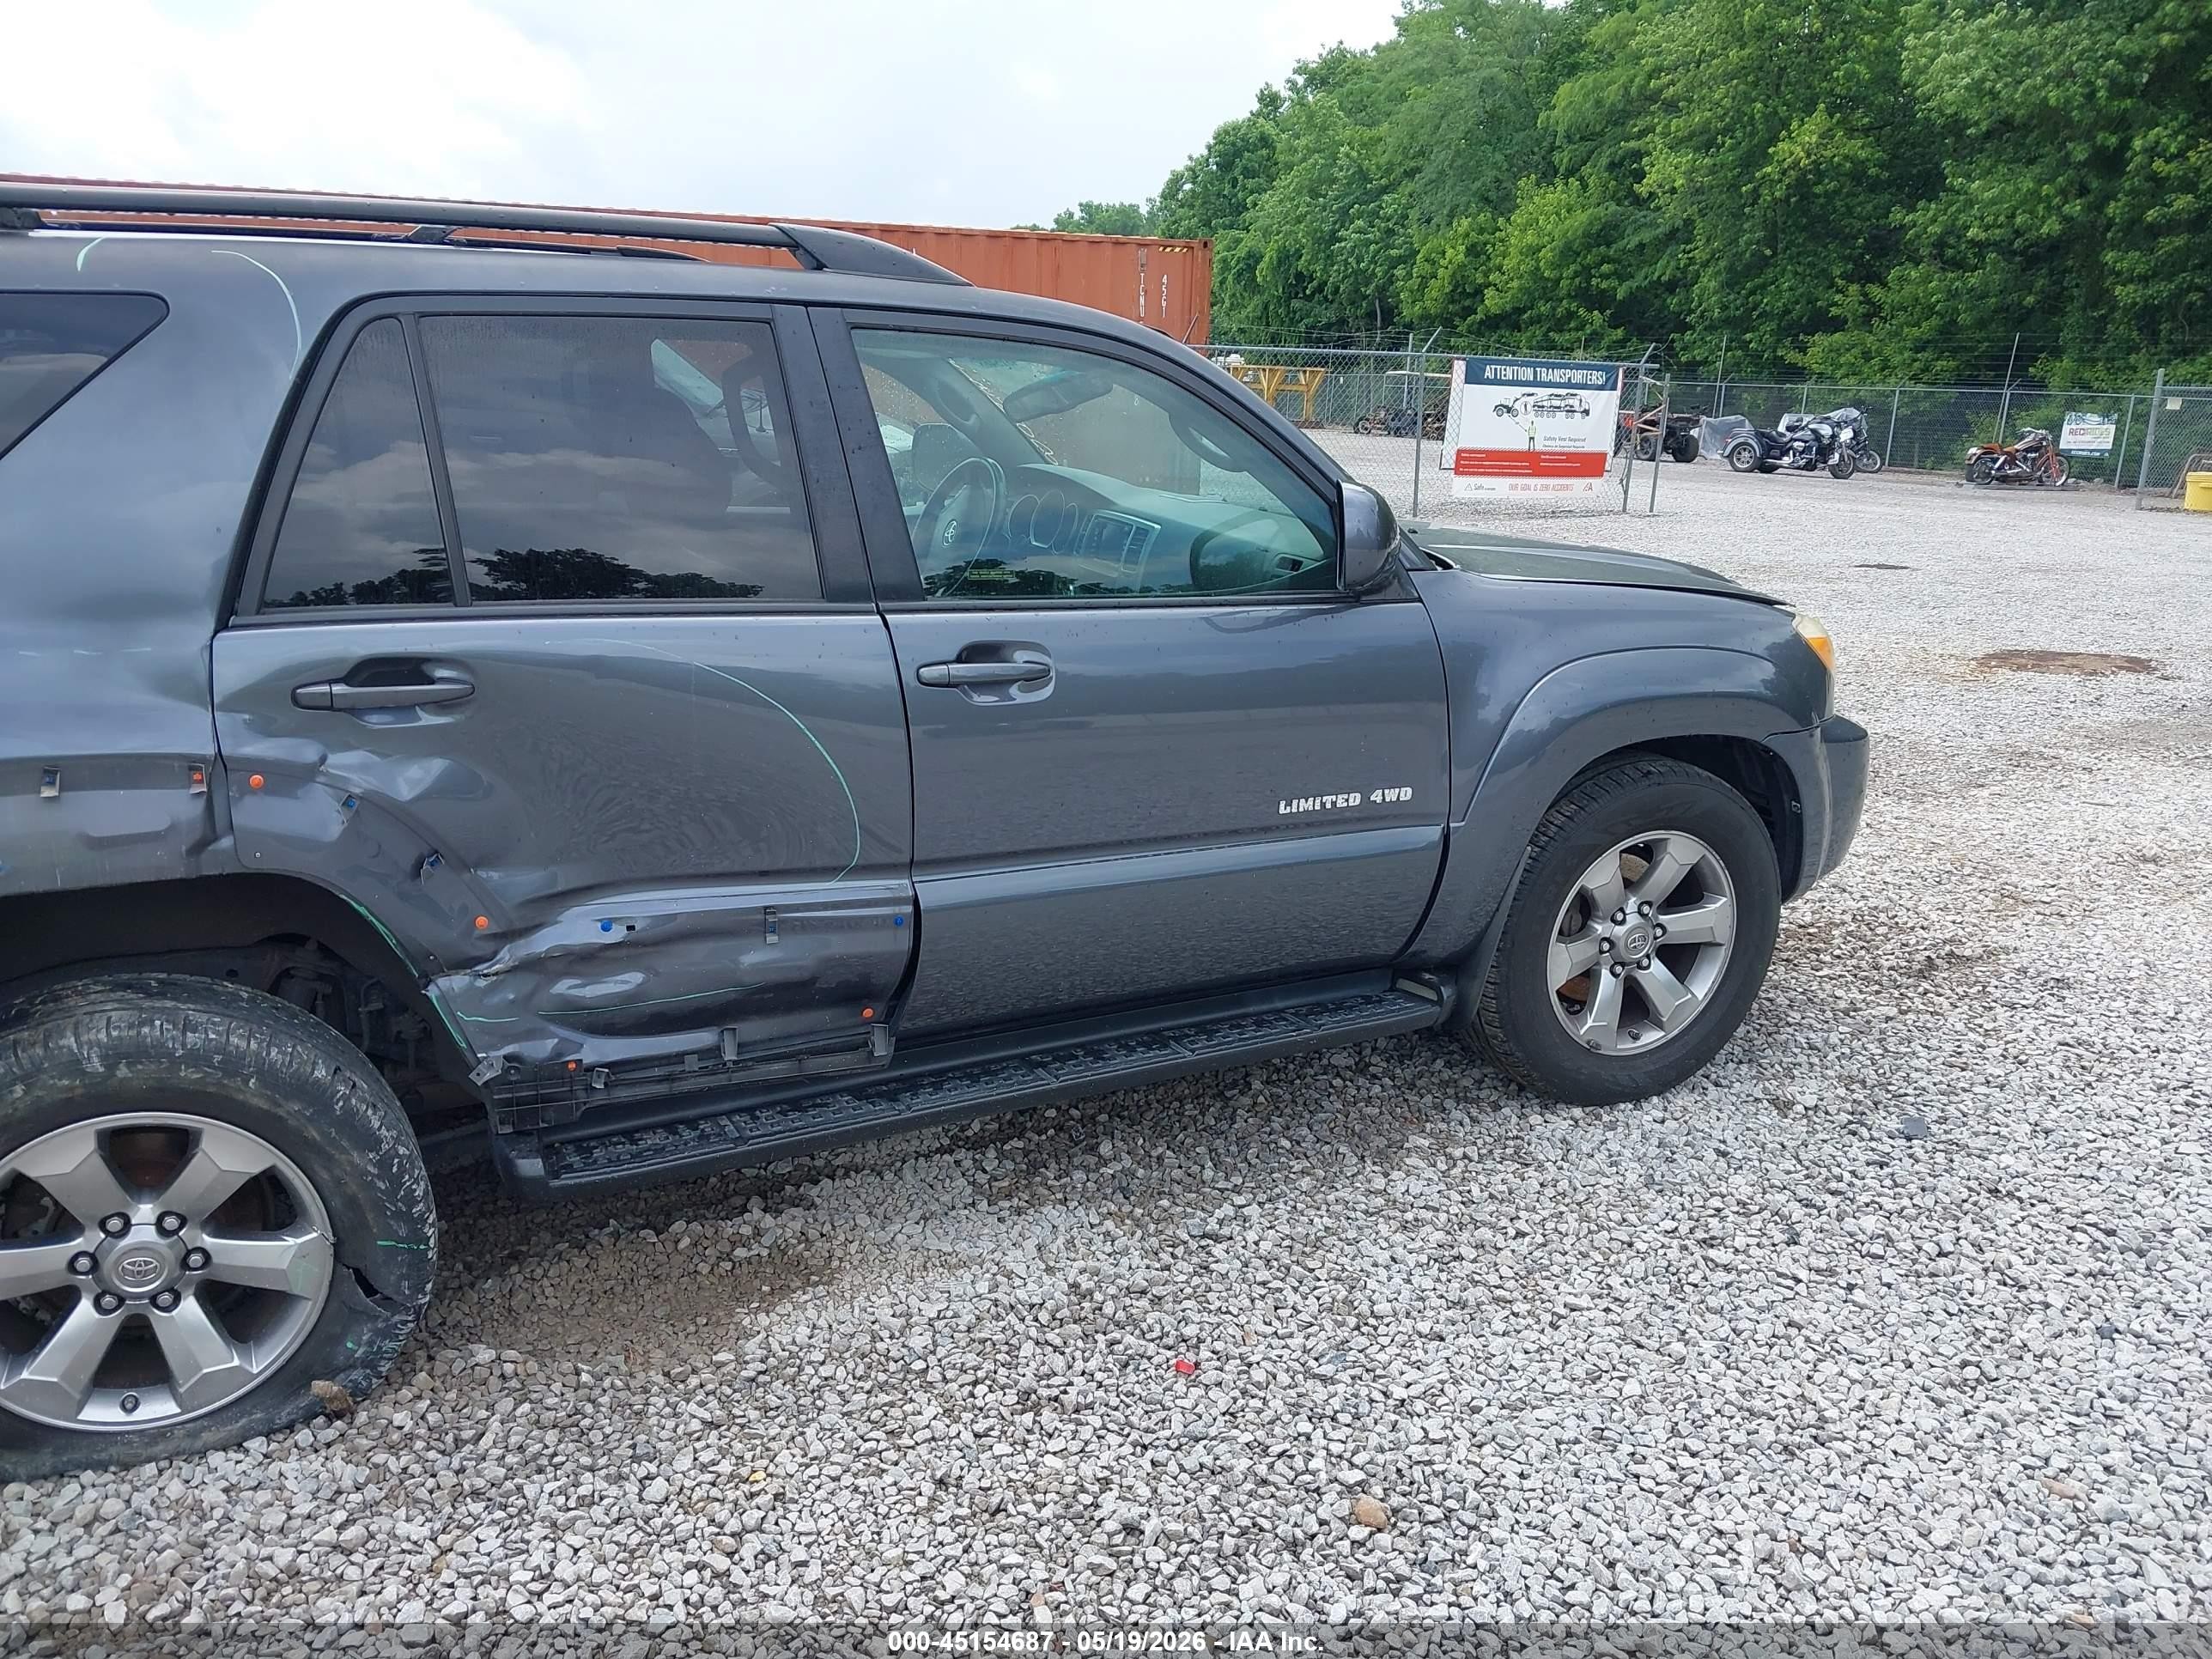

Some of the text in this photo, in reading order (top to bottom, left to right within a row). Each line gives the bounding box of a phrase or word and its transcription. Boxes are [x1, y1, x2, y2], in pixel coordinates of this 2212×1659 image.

[1484, 364, 1606, 386] ATTENTION TRANSPORTERS!
[1278, 787, 1413, 815] LIMITED 4WD
